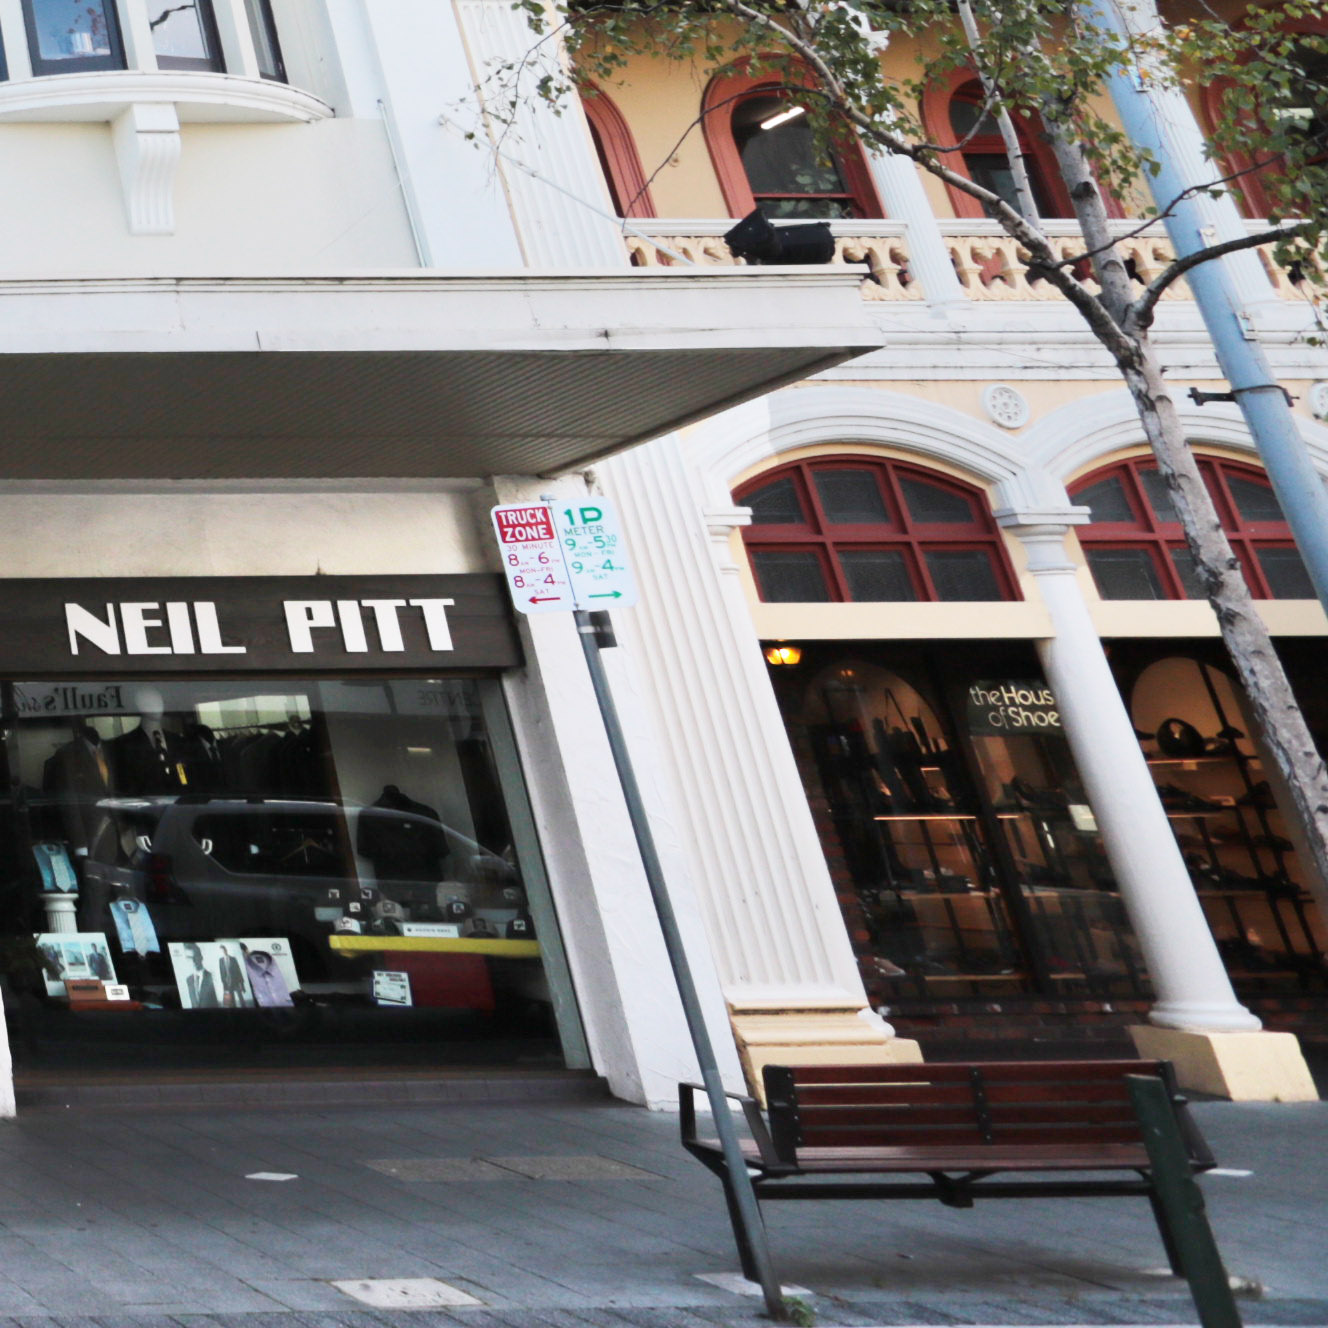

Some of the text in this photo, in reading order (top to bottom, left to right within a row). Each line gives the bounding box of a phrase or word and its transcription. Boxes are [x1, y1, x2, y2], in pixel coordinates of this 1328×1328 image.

[499, 508, 547, 525] TRUCK
[564, 506, 603, 526] 1P
[504, 525, 550, 542] ZONE
[564, 525, 604, 536] METER
[522, 542, 554, 550] MINUTE
[64, 598, 455, 655] NEIL PITT
[969, 685, 1055, 706] the Hous
[988, 706, 1061, 729] of Shoe
